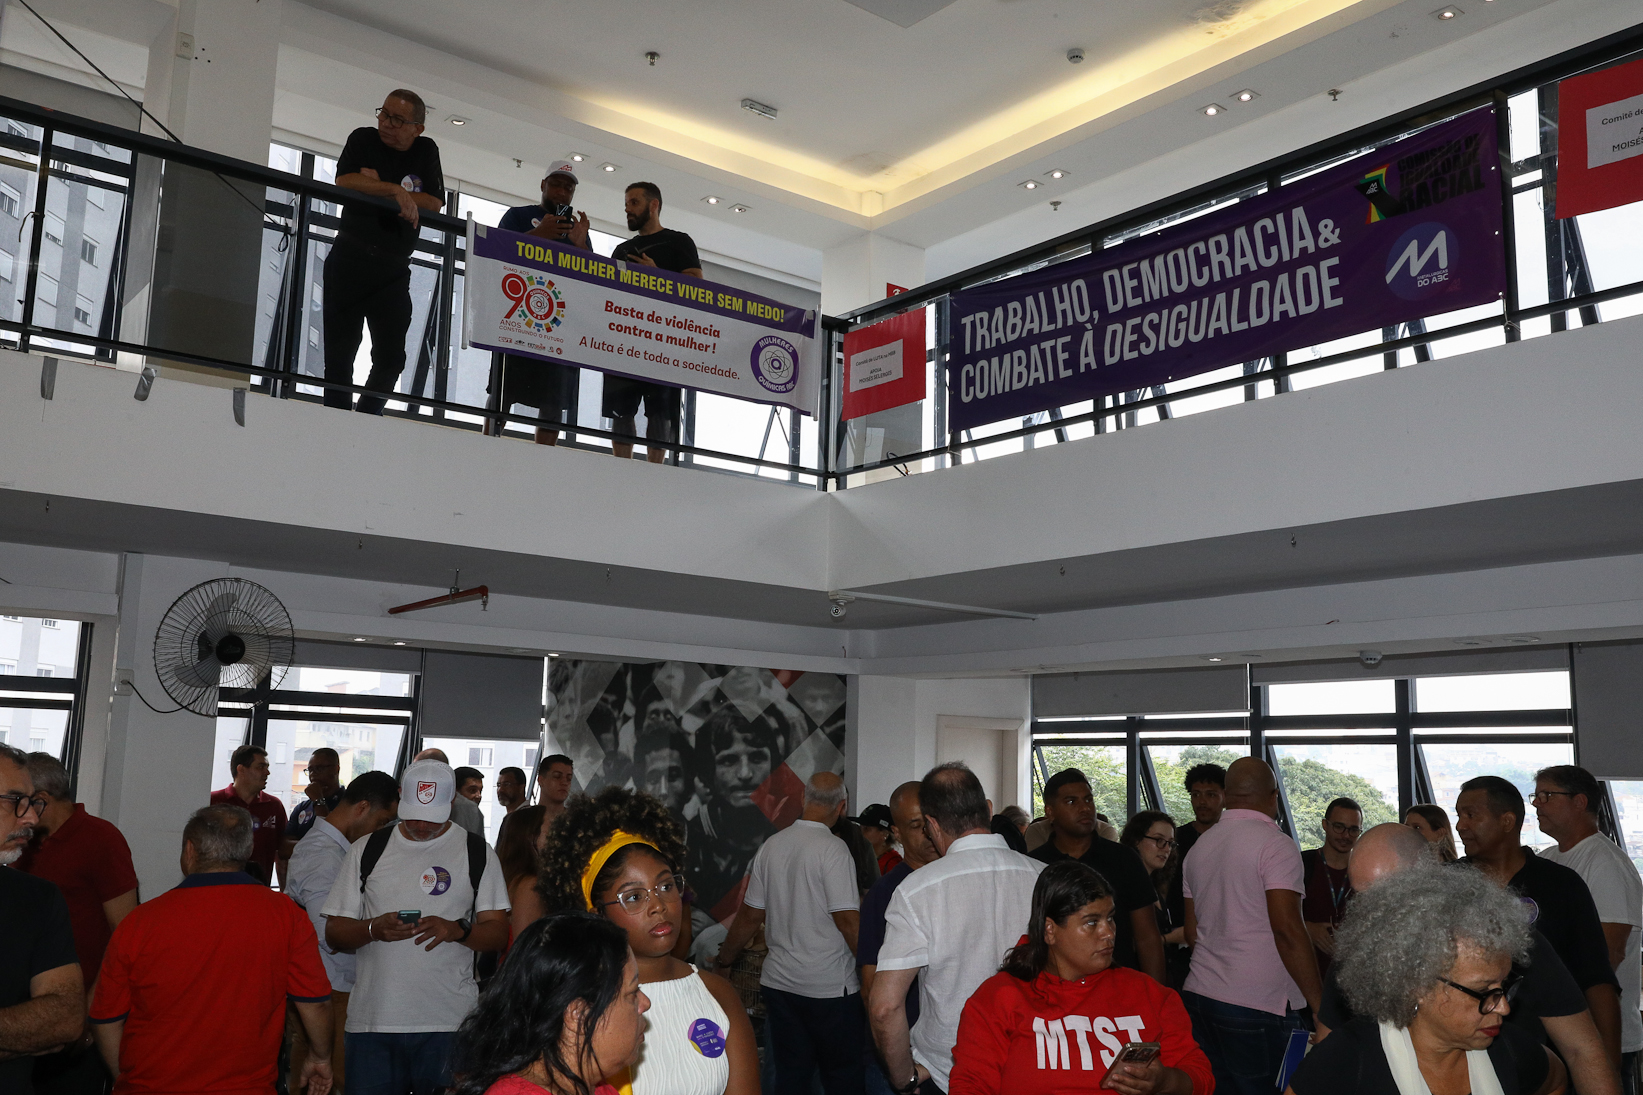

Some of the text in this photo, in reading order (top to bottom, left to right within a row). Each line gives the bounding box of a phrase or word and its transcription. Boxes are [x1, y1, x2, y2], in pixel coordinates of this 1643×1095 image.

[1602, 111, 1633, 125] Comitê
[1398, 164, 1485, 214] RACIAL
[517, 241, 784, 323] TODA MULHER MERECE VIVER SEM MEDO!
[961, 277, 1100, 355] TRABALHO,
[1102, 206, 1314, 315] DEMOCRACIA
[1417, 278, 1430, 288] DO
[499, 319, 522, 328] ANOS
[604, 301, 721, 338] Basta de violência
[608, 322, 652, 340] contra
[655, 333, 663, 342] a
[960, 257, 1343, 403] COMBATE À DESIGUALDADE
[498, 325, 538, 337] CONSTRUINDO
[544, 335, 564, 344] FUTURO
[758, 336, 795, 353] MULHERES
[579, 335, 741, 380] A luta é de toda a sociedade.
[758, 375, 786, 392] QUÍMICAS
[1032, 1014, 1146, 1071] MTST
